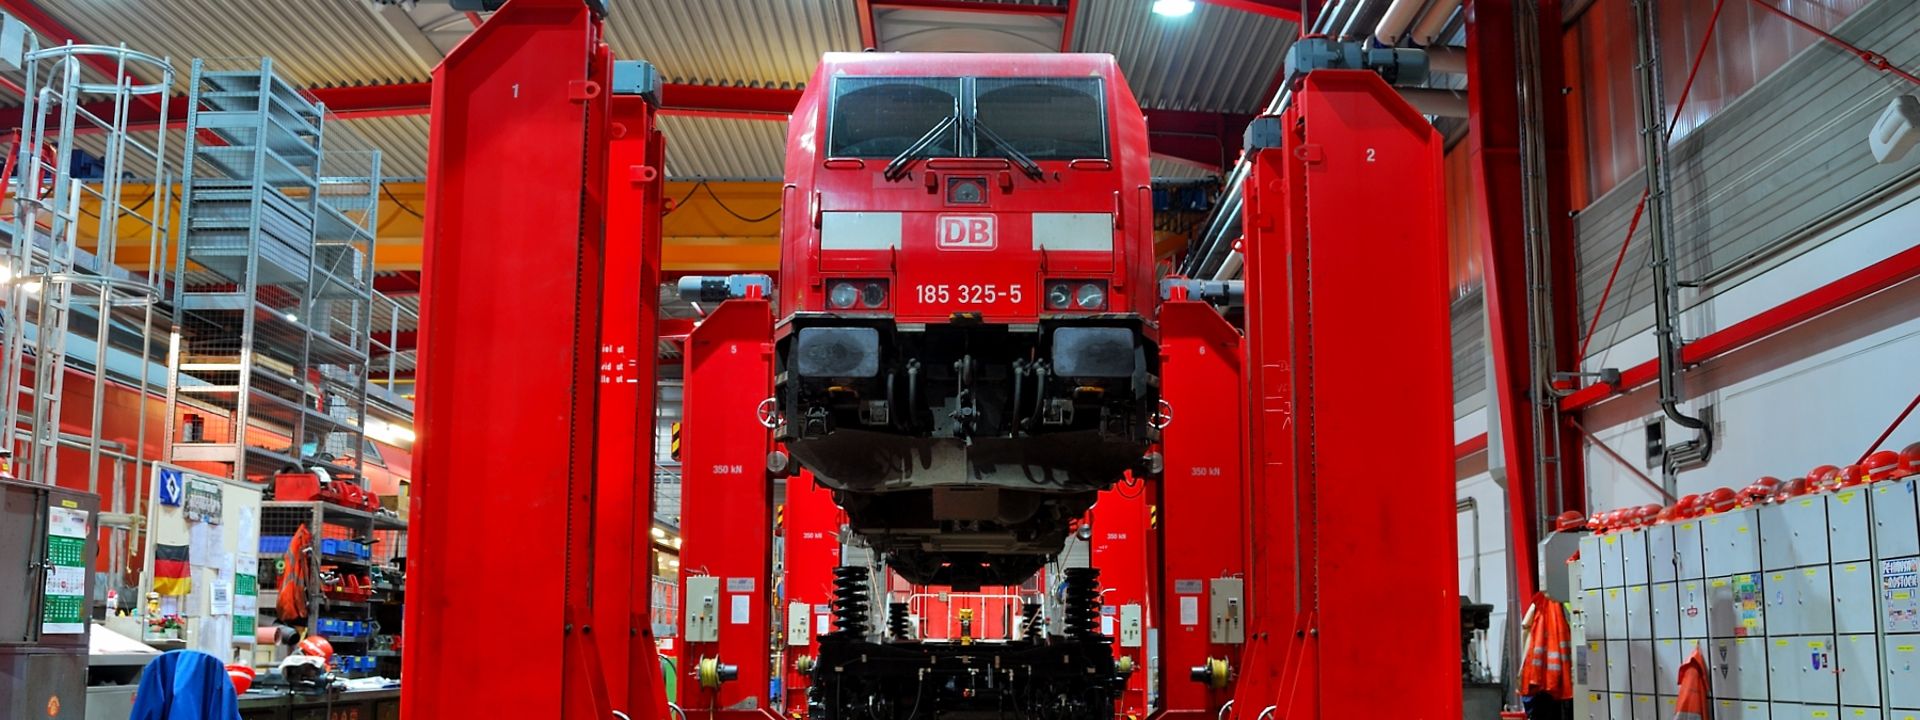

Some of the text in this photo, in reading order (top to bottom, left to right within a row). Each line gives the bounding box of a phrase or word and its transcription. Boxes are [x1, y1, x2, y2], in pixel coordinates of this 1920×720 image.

[512, 83, 519, 98] 1
[1366, 148, 1376, 162] 2
[944, 219, 989, 243] DB
[916, 284, 1022, 304] 185 325-5
[1199, 346, 1206, 355] 6
[712, 465, 743, 474] 350 kN
[1191, 467, 1220, 476] 350 kN
